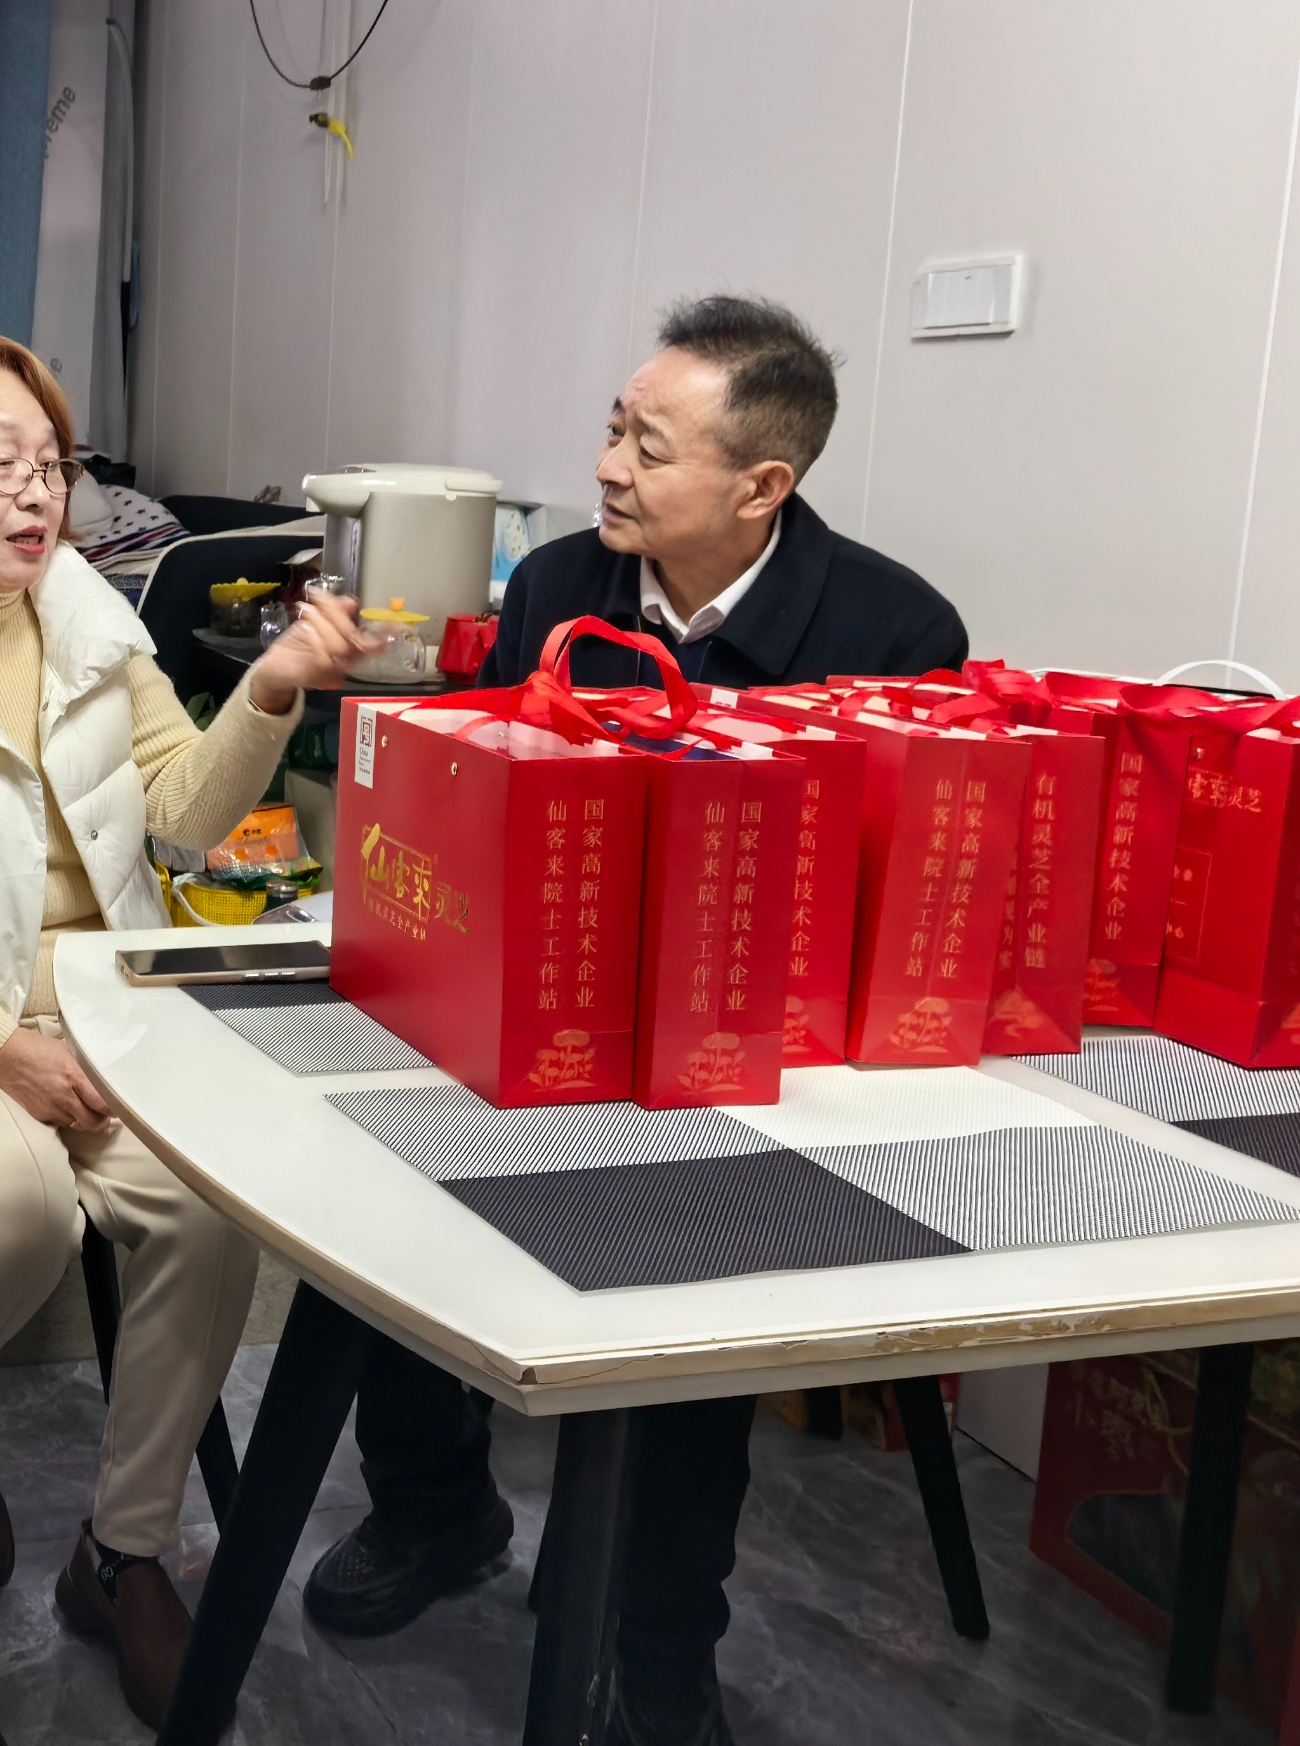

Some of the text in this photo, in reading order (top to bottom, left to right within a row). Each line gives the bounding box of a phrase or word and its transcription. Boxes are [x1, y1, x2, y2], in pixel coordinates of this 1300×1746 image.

[538, 800, 567, 1011] 仙客来院士工作站
[575, 798, 605, 1009] 国家高新技术企业
[690, 802, 725, 1013] 仙客来院士工作站
[725, 801, 762, 1011] 国家高新技术企业
[789, 779, 820, 976] 国家高新技术企业
[905, 779, 952, 977] 仙客来院士工作站
[940, 781, 986, 978] 国家高新技术企业
[1024, 773, 1056, 968] 有机灵芝全产业链
[1105, 752, 1143, 940] 国家高新技术企业
